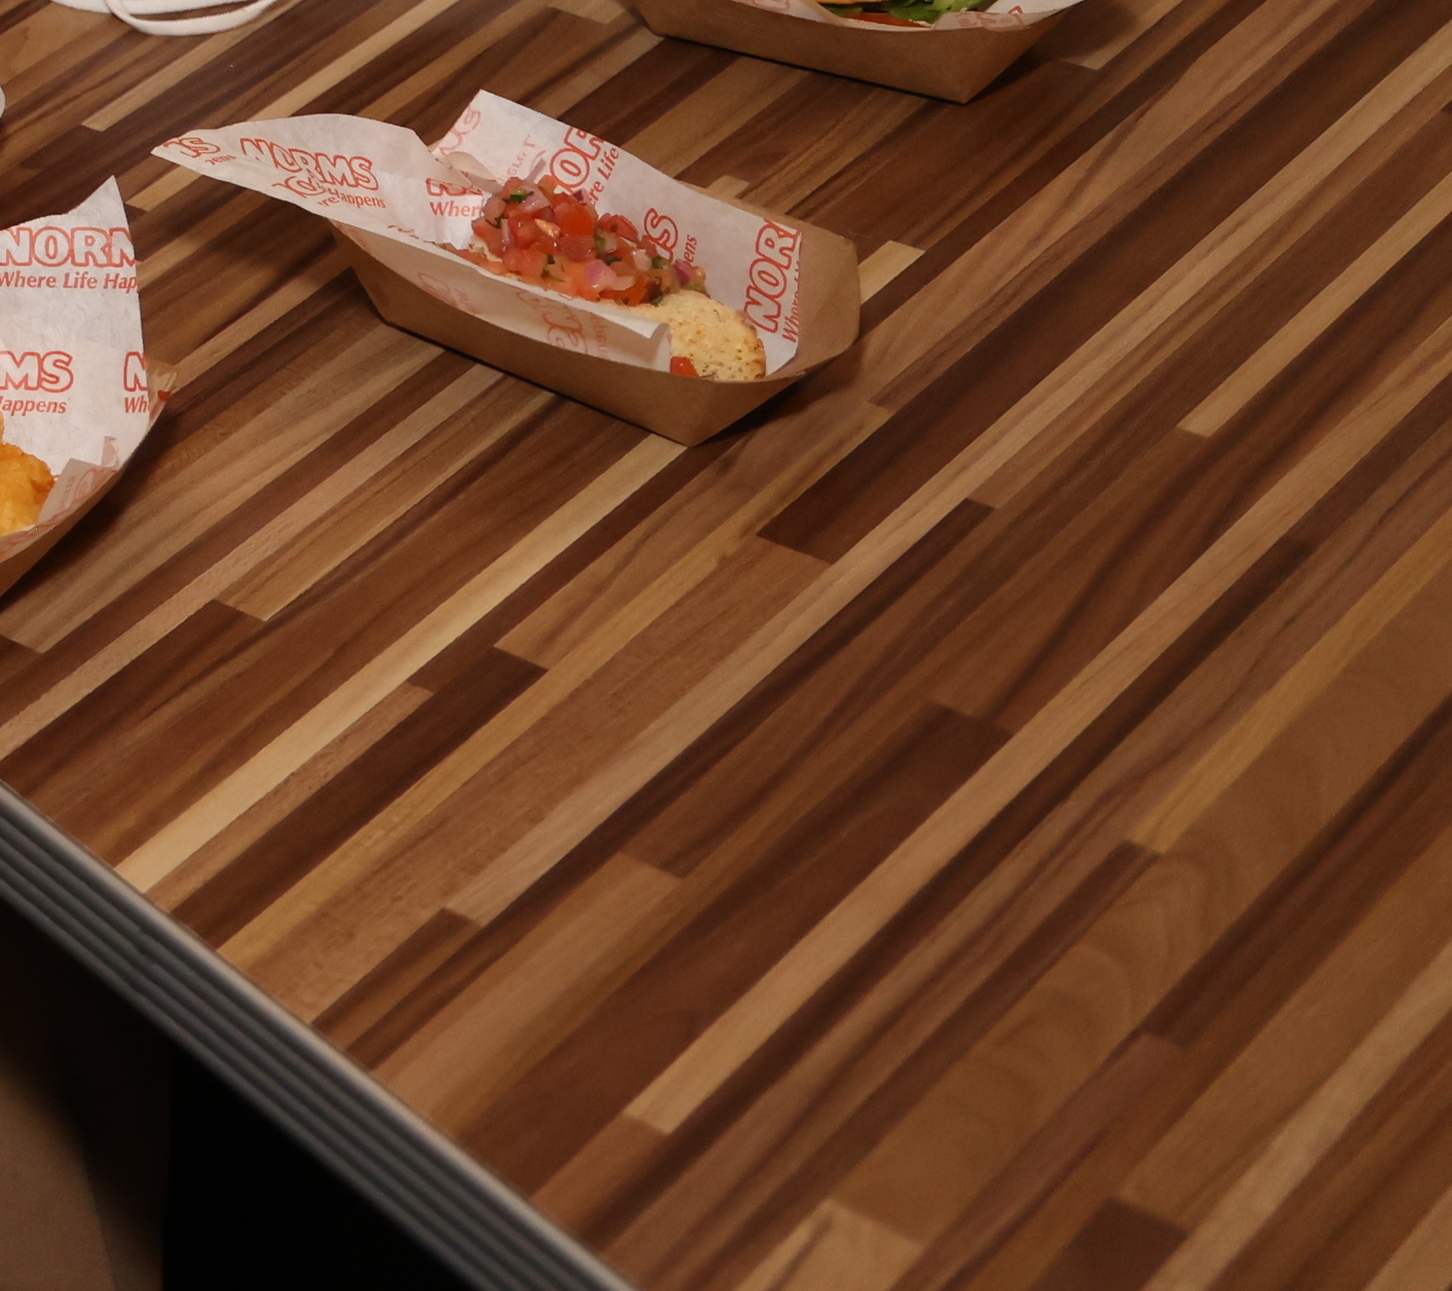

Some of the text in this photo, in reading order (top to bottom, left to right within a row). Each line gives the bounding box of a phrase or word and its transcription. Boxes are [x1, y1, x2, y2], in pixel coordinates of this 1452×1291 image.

[597, 146, 620, 180] Life
[429, 201, 481, 219] Wher
[63, 272, 98, 290] Life
[744, 219, 803, 334] NOR
